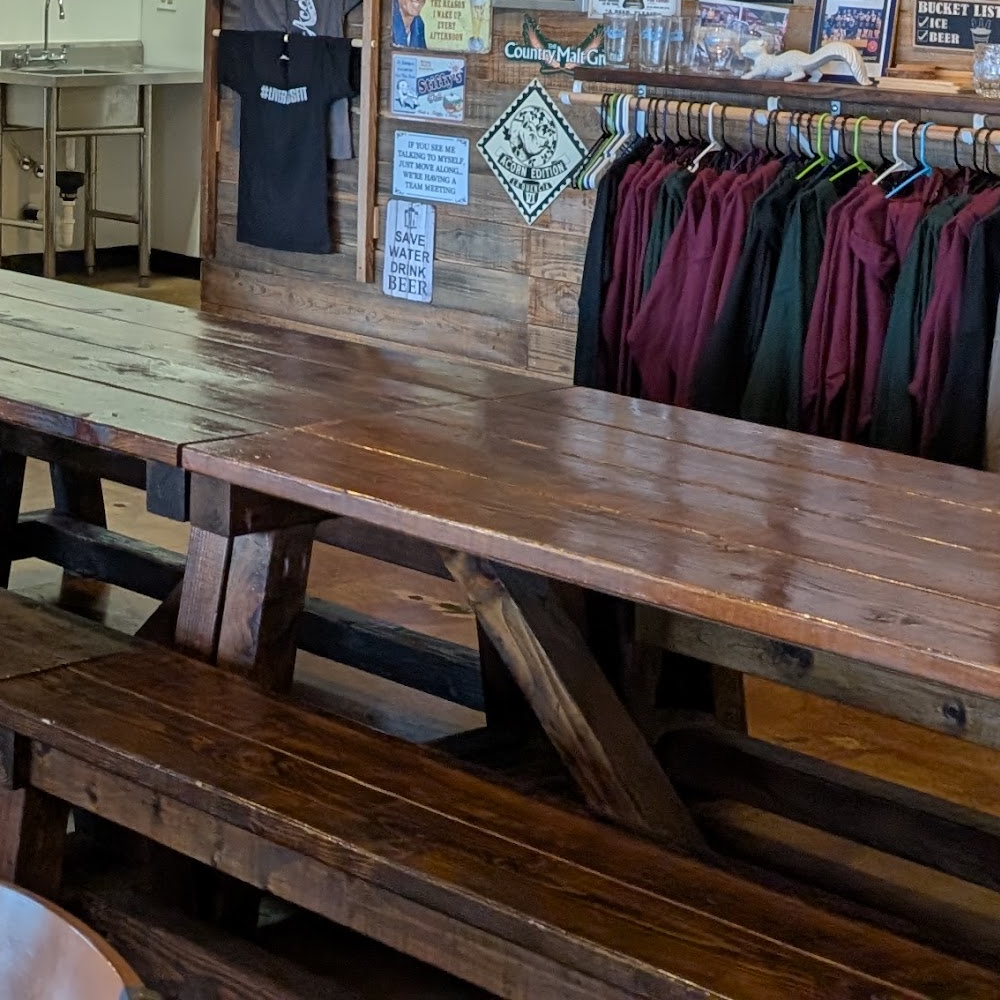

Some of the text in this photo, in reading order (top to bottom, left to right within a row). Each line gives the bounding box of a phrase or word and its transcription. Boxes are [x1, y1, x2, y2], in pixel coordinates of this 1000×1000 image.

[431, 0, 465, 9] THE REASON
[918, 0, 970, 16] BUCKET
[437, 11, 455, 20] WAKE
[455, 12, 463, 20] UP
[437, 21, 456, 31] EVERY
[930, 17, 948, 29] ICE
[429, 32, 463, 42] AFTERNOON
[929, 30, 960, 44] BEER
[504, 41, 557, 62] Country
[557, 47, 585, 65] Malt
[415, 142, 430, 150] YOU
[431, 144, 443, 152] SEE
[398, 150, 426, 161] TALKING
[427, 153, 437, 161] TO
[399, 161, 414, 169] JUST
[415, 163, 435, 171] MOVE
[500, 156, 566, 179] ACORN EDITION
[403, 171, 423, 180] WE'RE
[424, 174, 450, 184] HAVING
[405, 182, 456, 195] TEAM MEETING
[395, 231, 425, 247] SAVE
[389, 246, 430, 263] WATER
[390, 262, 427, 279] DRINK
[388, 275, 428, 296] BEER
